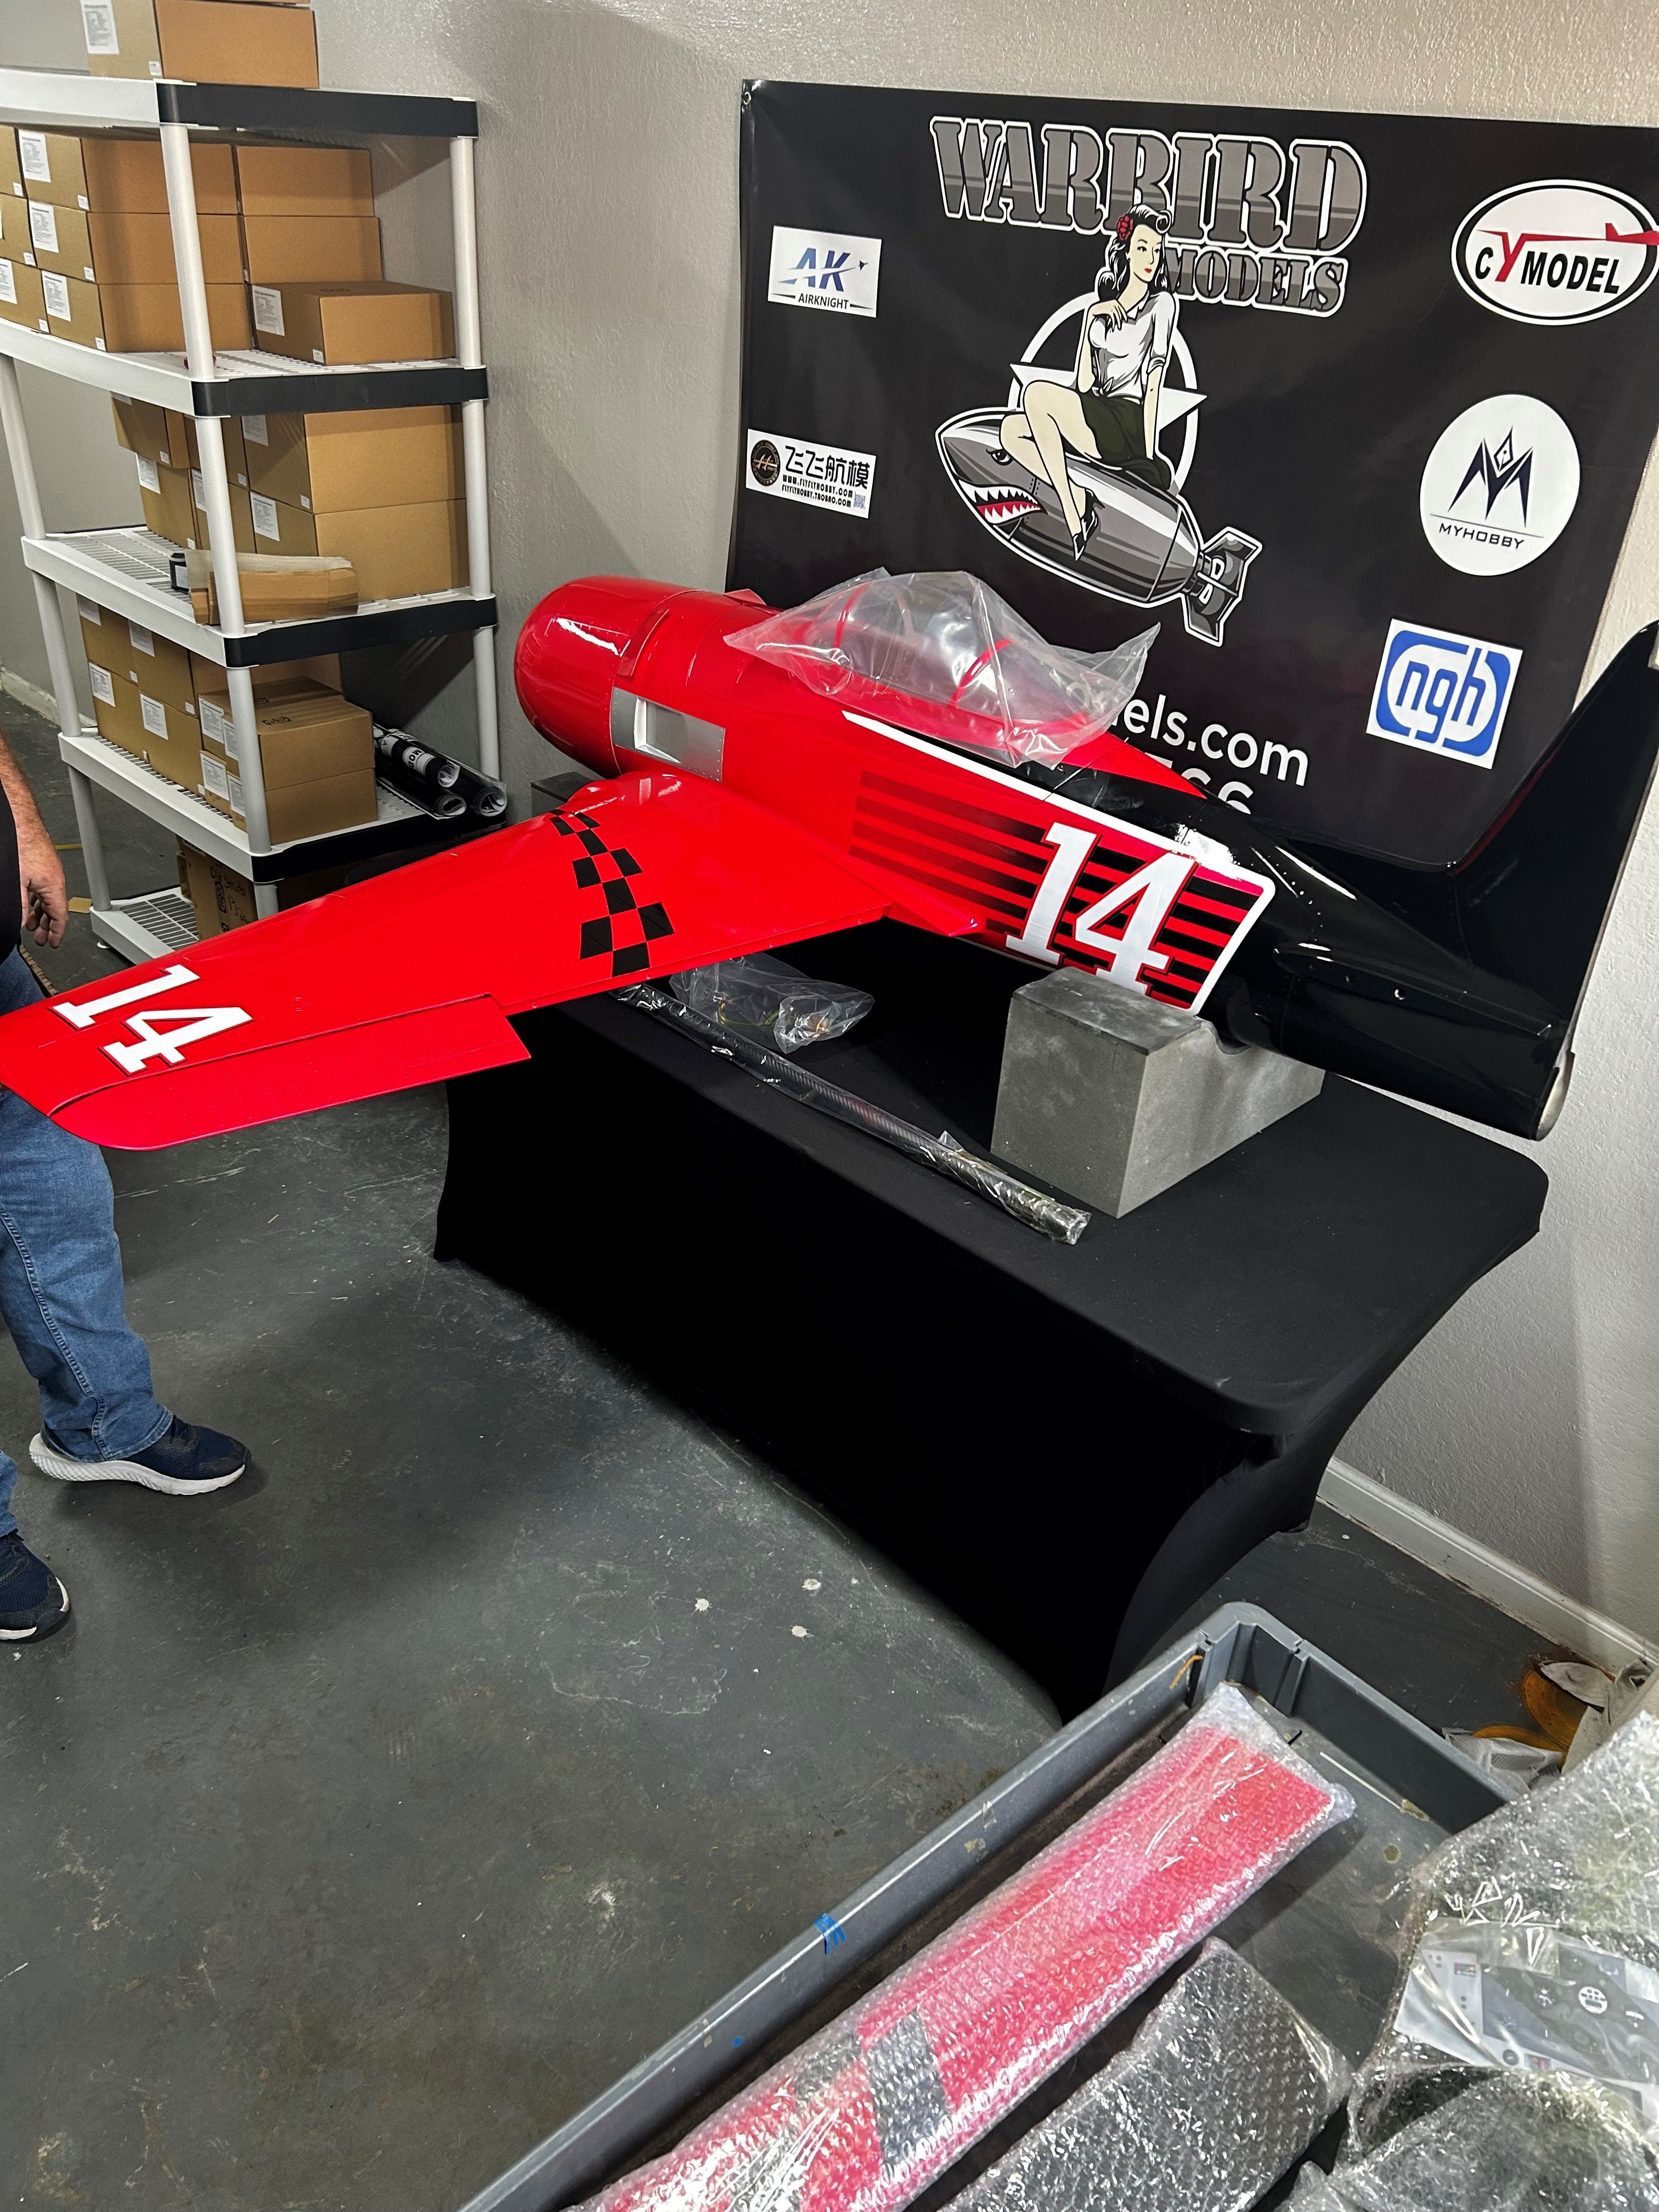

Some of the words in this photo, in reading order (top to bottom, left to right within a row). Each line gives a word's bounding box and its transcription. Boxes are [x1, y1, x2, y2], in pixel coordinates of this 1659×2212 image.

[930, 116, 1367, 256] WARBIRD
[778, 247, 851, 292] AK
[798, 292, 850, 310] AIRKNIGHT
[1166, 243, 1348, 317] MODELS
[785, 445, 870, 490] 飞飞航模
[1438, 522, 1526, 550] MYHOBBY
[1396, 647, 1486, 743] ngh
[1110, 694, 1310, 787] els.com
[1005, 822, 1198, 996] 14
[50, 963, 253, 1076] 14
